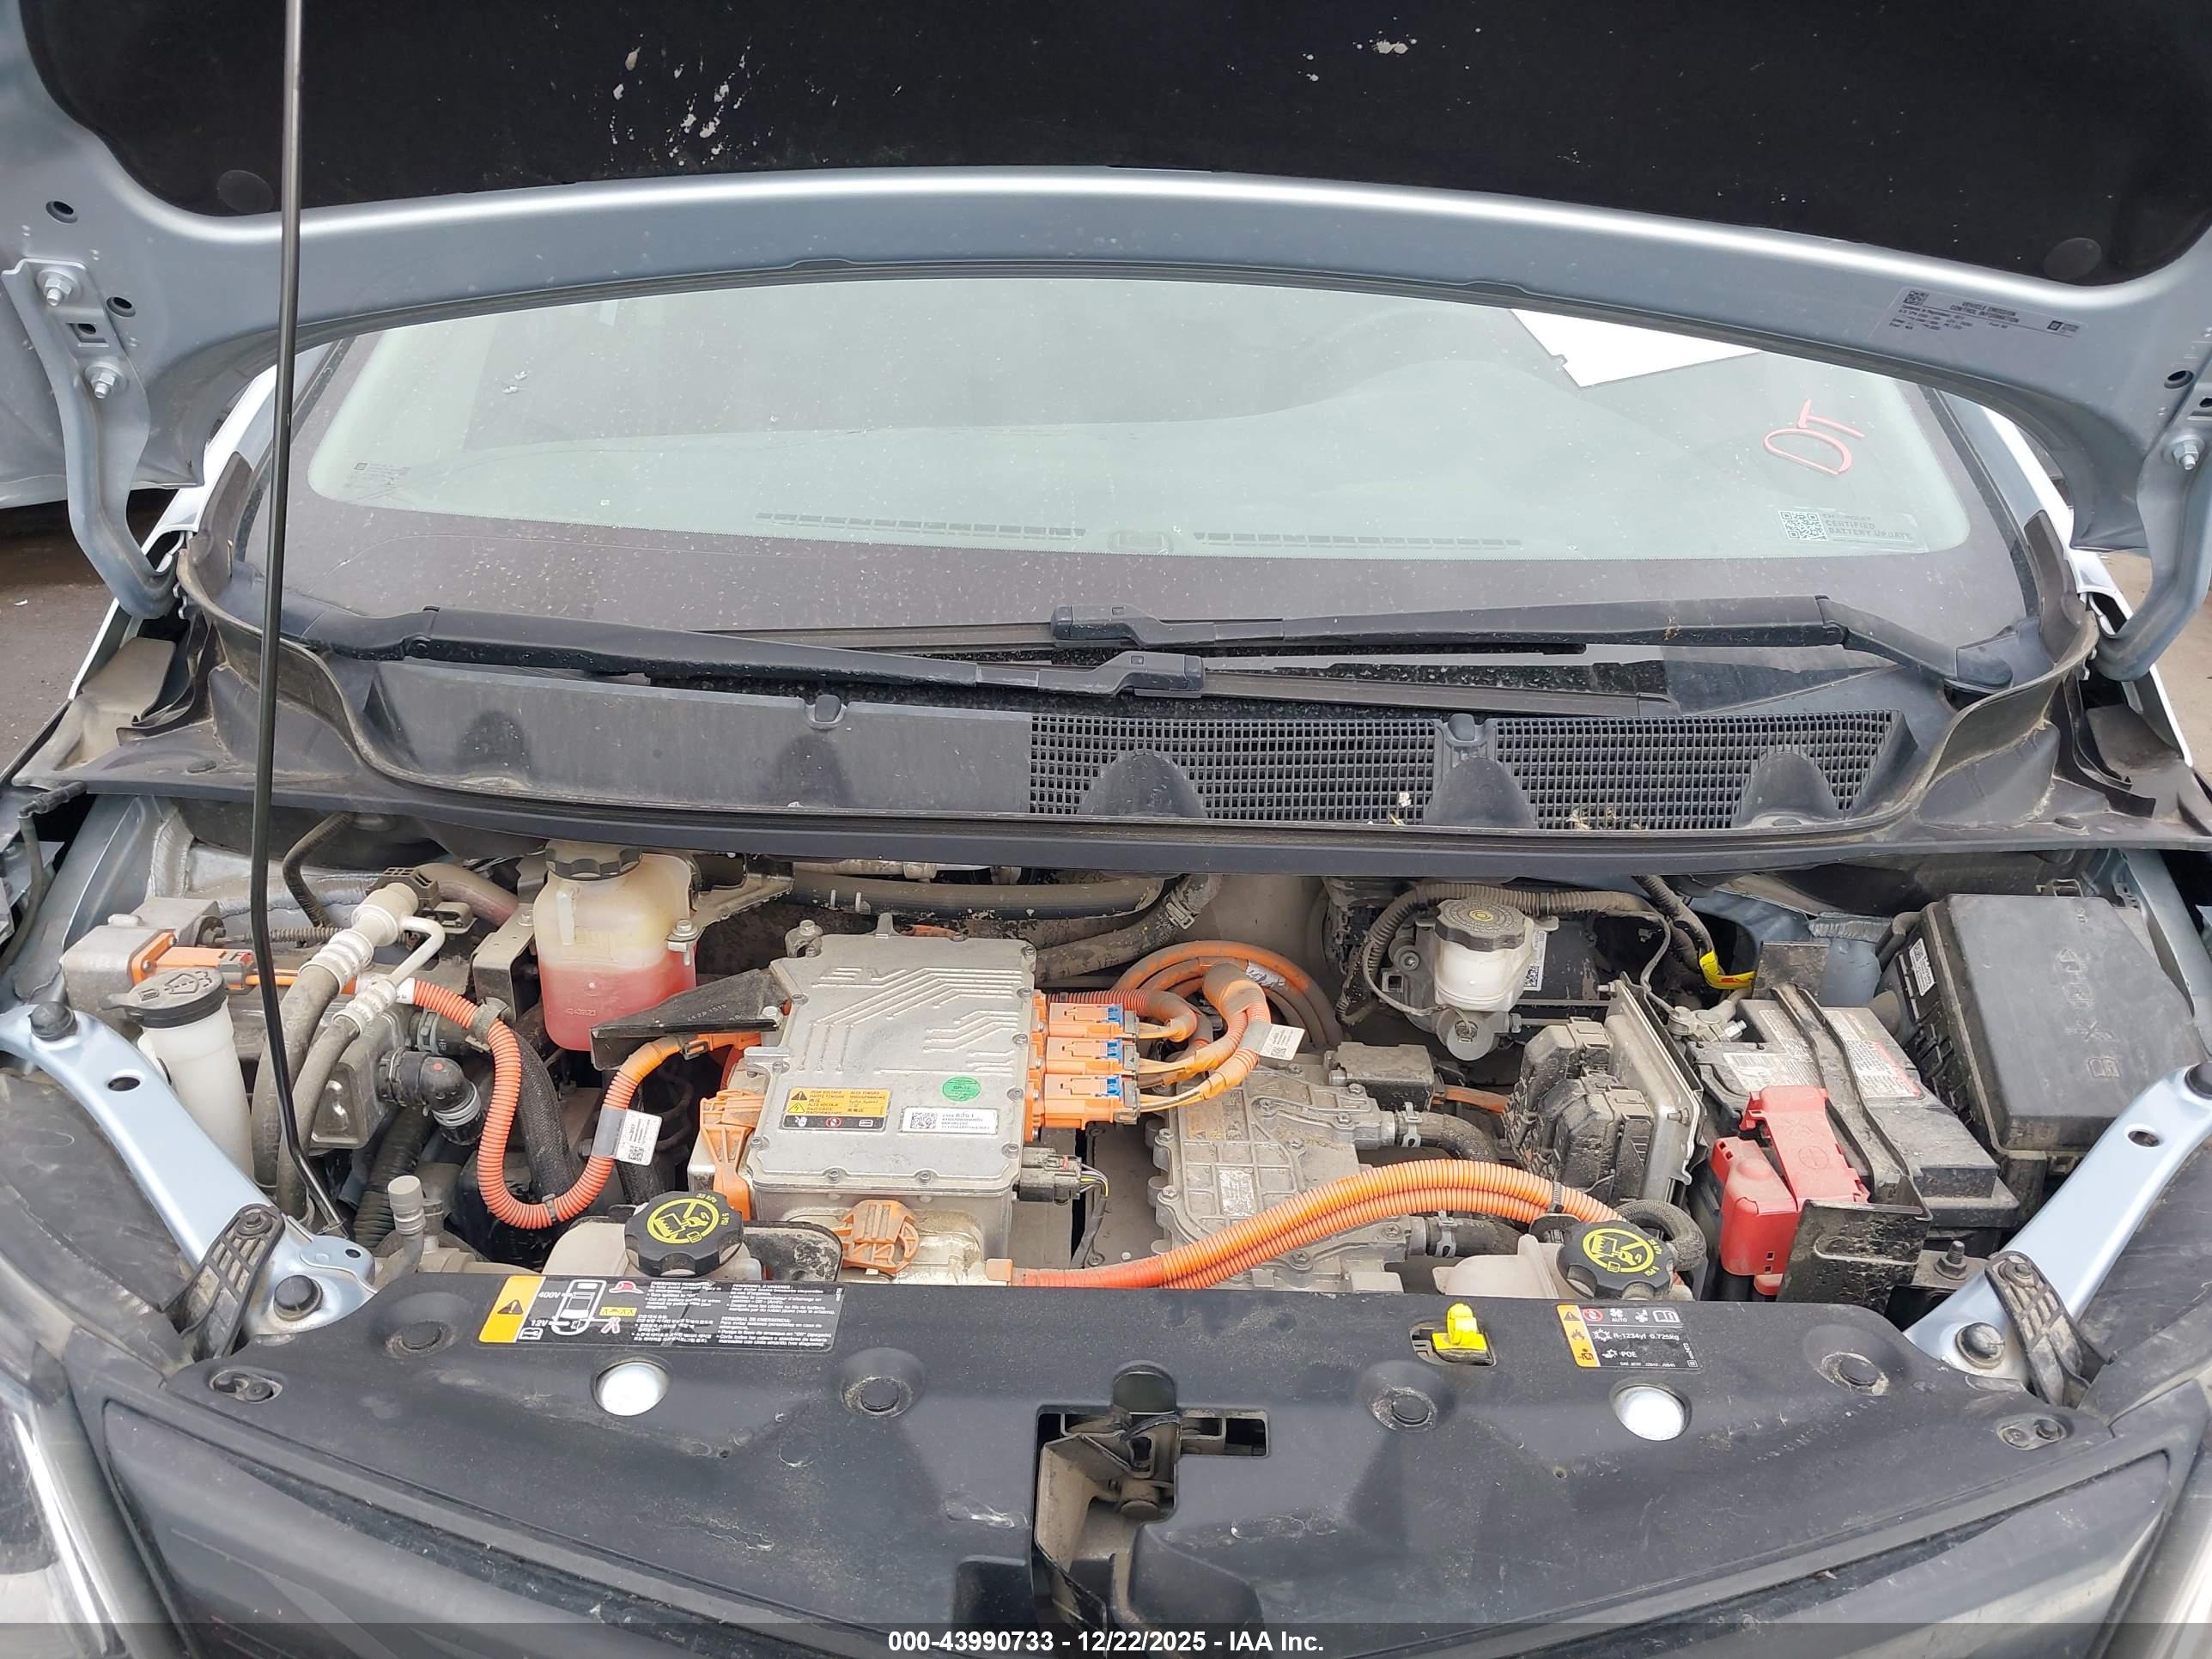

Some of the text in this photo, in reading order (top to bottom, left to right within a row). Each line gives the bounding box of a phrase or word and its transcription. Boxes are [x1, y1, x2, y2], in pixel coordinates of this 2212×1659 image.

[1826, 520, 1875, 530] CERTIFIED
[1828, 527, 1911, 538] BATTERY UPDATE
